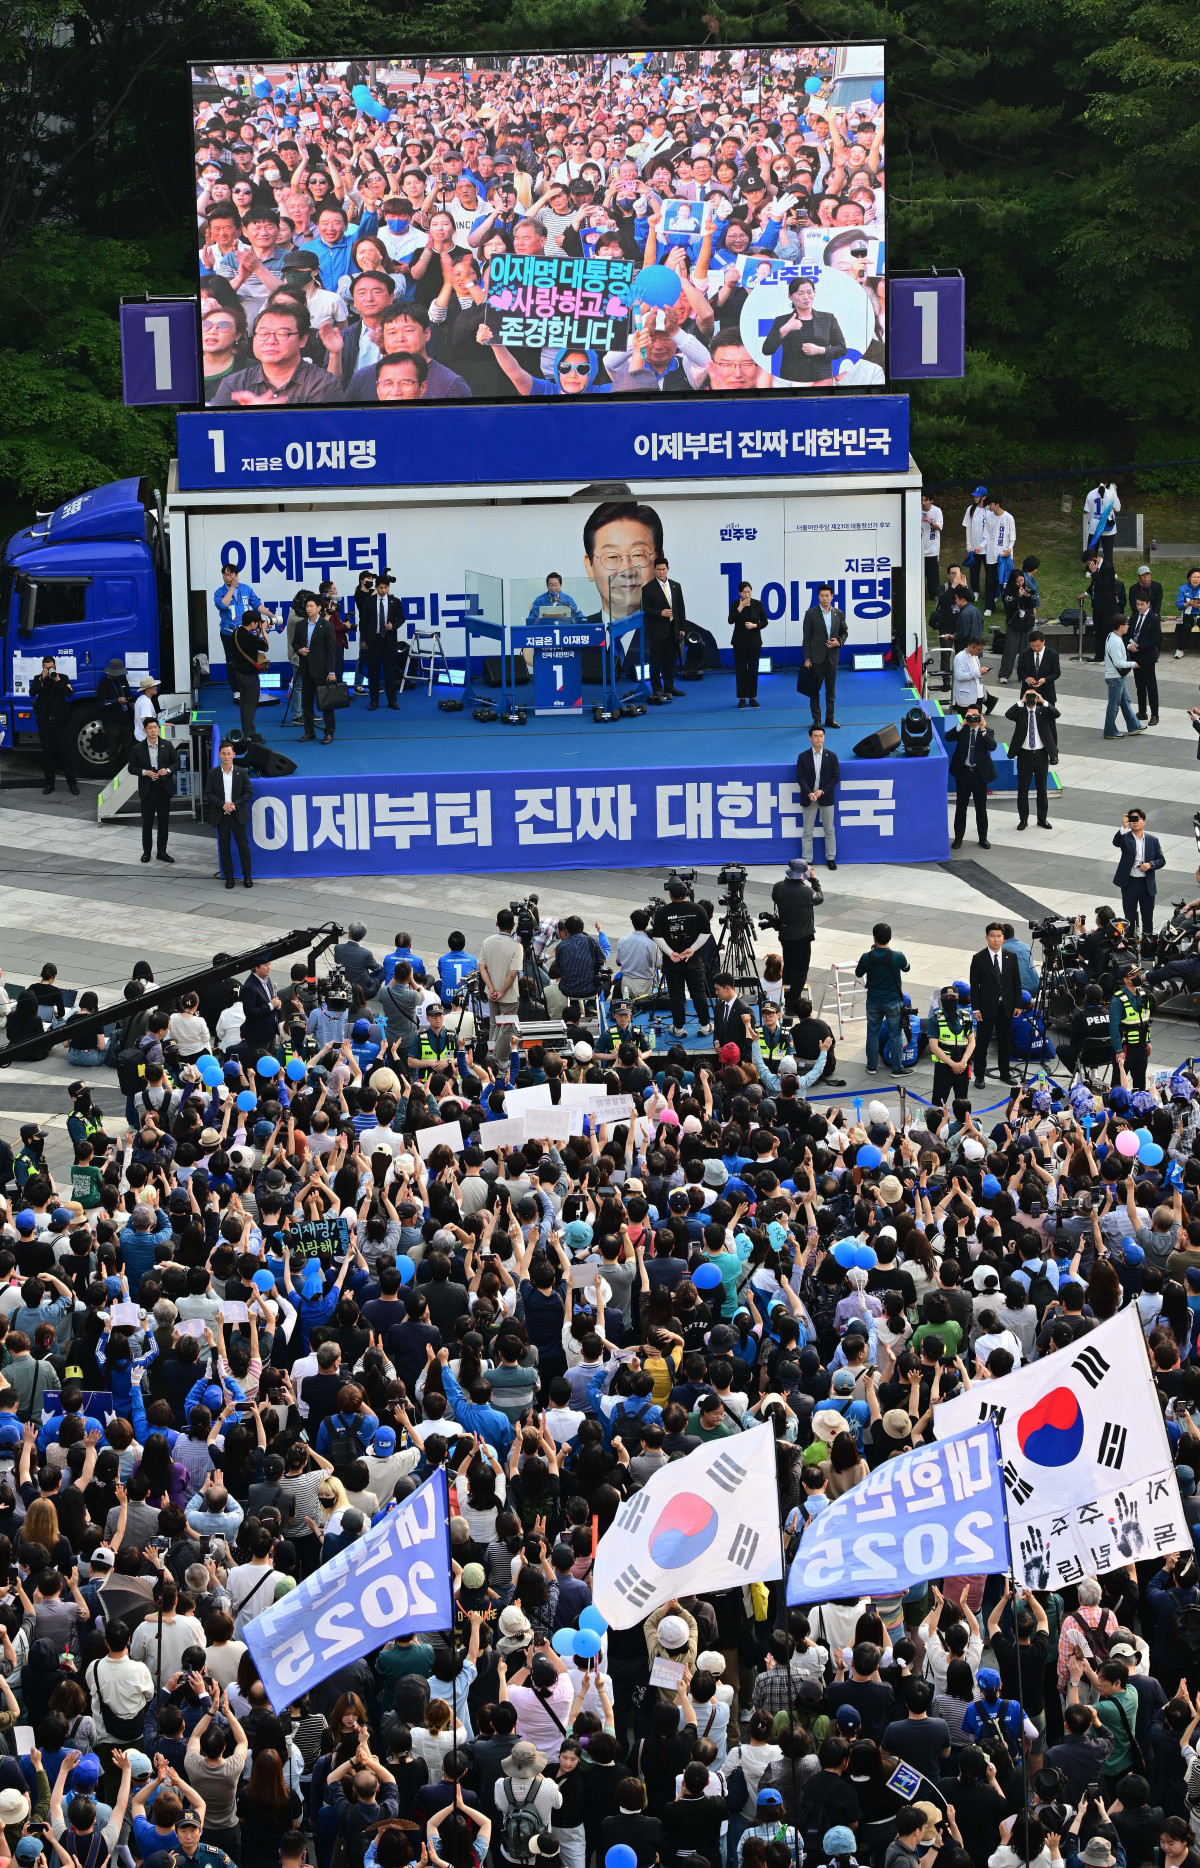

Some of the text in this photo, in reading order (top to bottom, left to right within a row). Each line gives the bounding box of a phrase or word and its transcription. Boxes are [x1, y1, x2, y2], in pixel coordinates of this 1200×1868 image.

[490, 254, 633, 295] 이재명 대통령
[510, 285, 604, 320] 사랑하고
[499, 315, 615, 350] 존경합니다
[913, 291, 938, 365] 1
[144, 316, 173, 391] 1
[208, 429, 377, 473] 1 지금은 이재명
[633, 427, 892, 461] 이제부터 진짜 대한민국
[720, 527, 757, 541] 민주당
[796, 523, 830, 531] 더불어민주당
[850, 522, 878, 530] 대통령선거
[220, 532, 388, 583] 이제부터
[845, 556, 892, 573] 지금은
[760, 577, 892, 622] 이재명
[526, 629, 590, 646] 지금은 1 이재명
[552, 664, 564, 691] 1
[251, 789, 493, 852] 이제부터
[515, 784, 637, 845] 진짜
[453, 963, 462, 985] 1
[290, 1220, 336, 1240] 이재명!
[295, 1238, 338, 1258] 사랑해!
